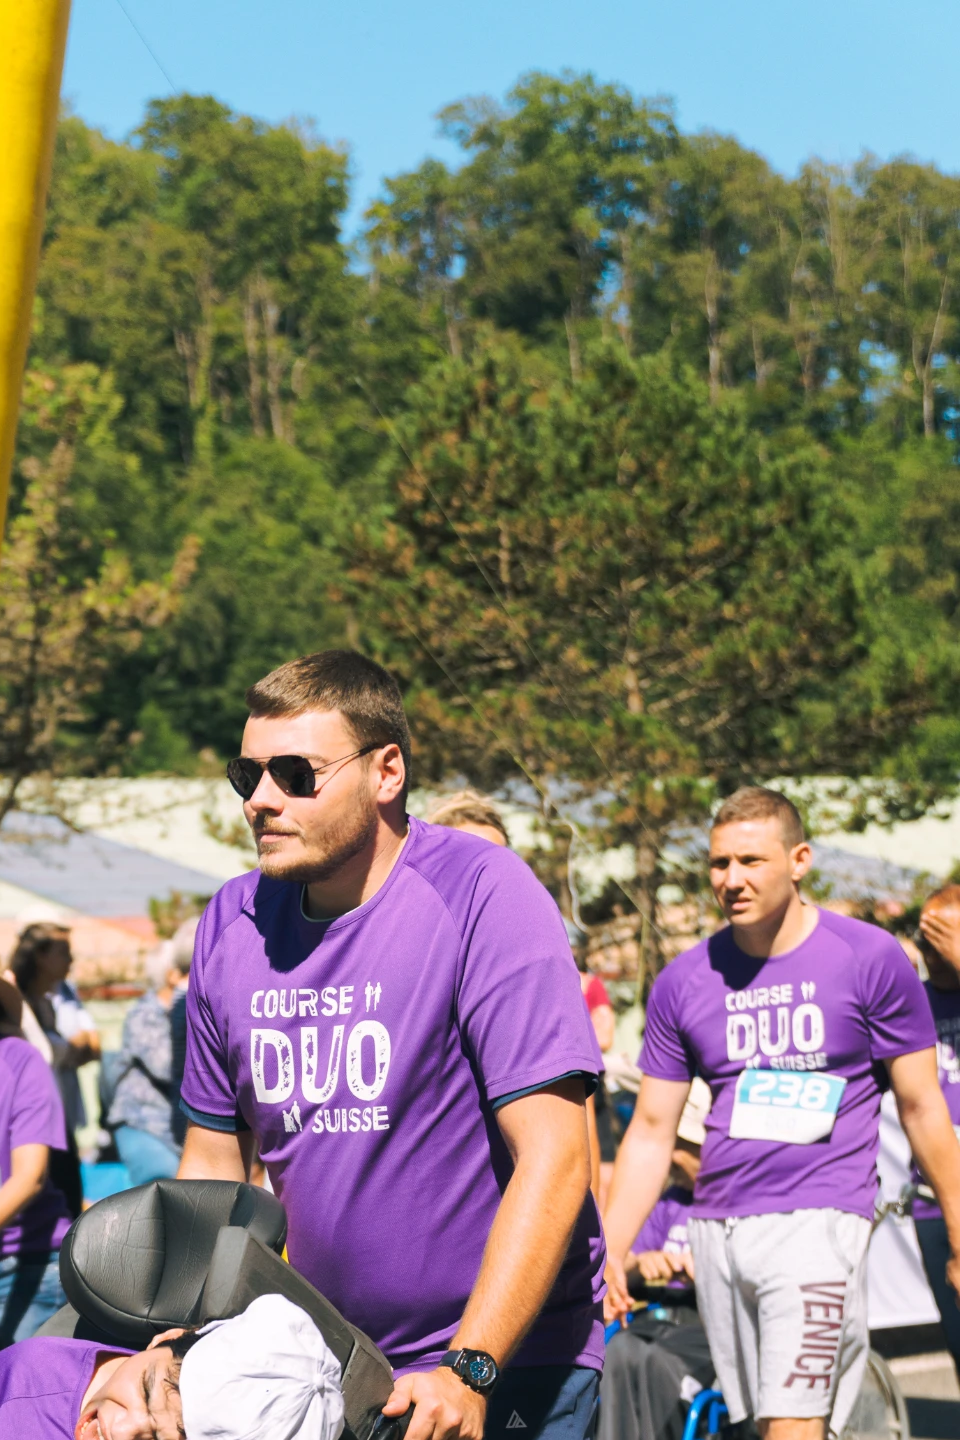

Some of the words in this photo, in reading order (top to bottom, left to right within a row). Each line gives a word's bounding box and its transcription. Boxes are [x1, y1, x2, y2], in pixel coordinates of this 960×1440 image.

[250, 986, 355, 1019] COURSE
[725, 984, 793, 1012] COURSE
[727, 1003, 825, 1062] DUO
[250, 1020, 392, 1105] DUO
[769, 1053, 828, 1071] SUISSE
[748, 1072, 831, 1111] 238
[312, 1106, 390, 1134] SUISSE
[783, 1281, 847, 1391] VENICE
